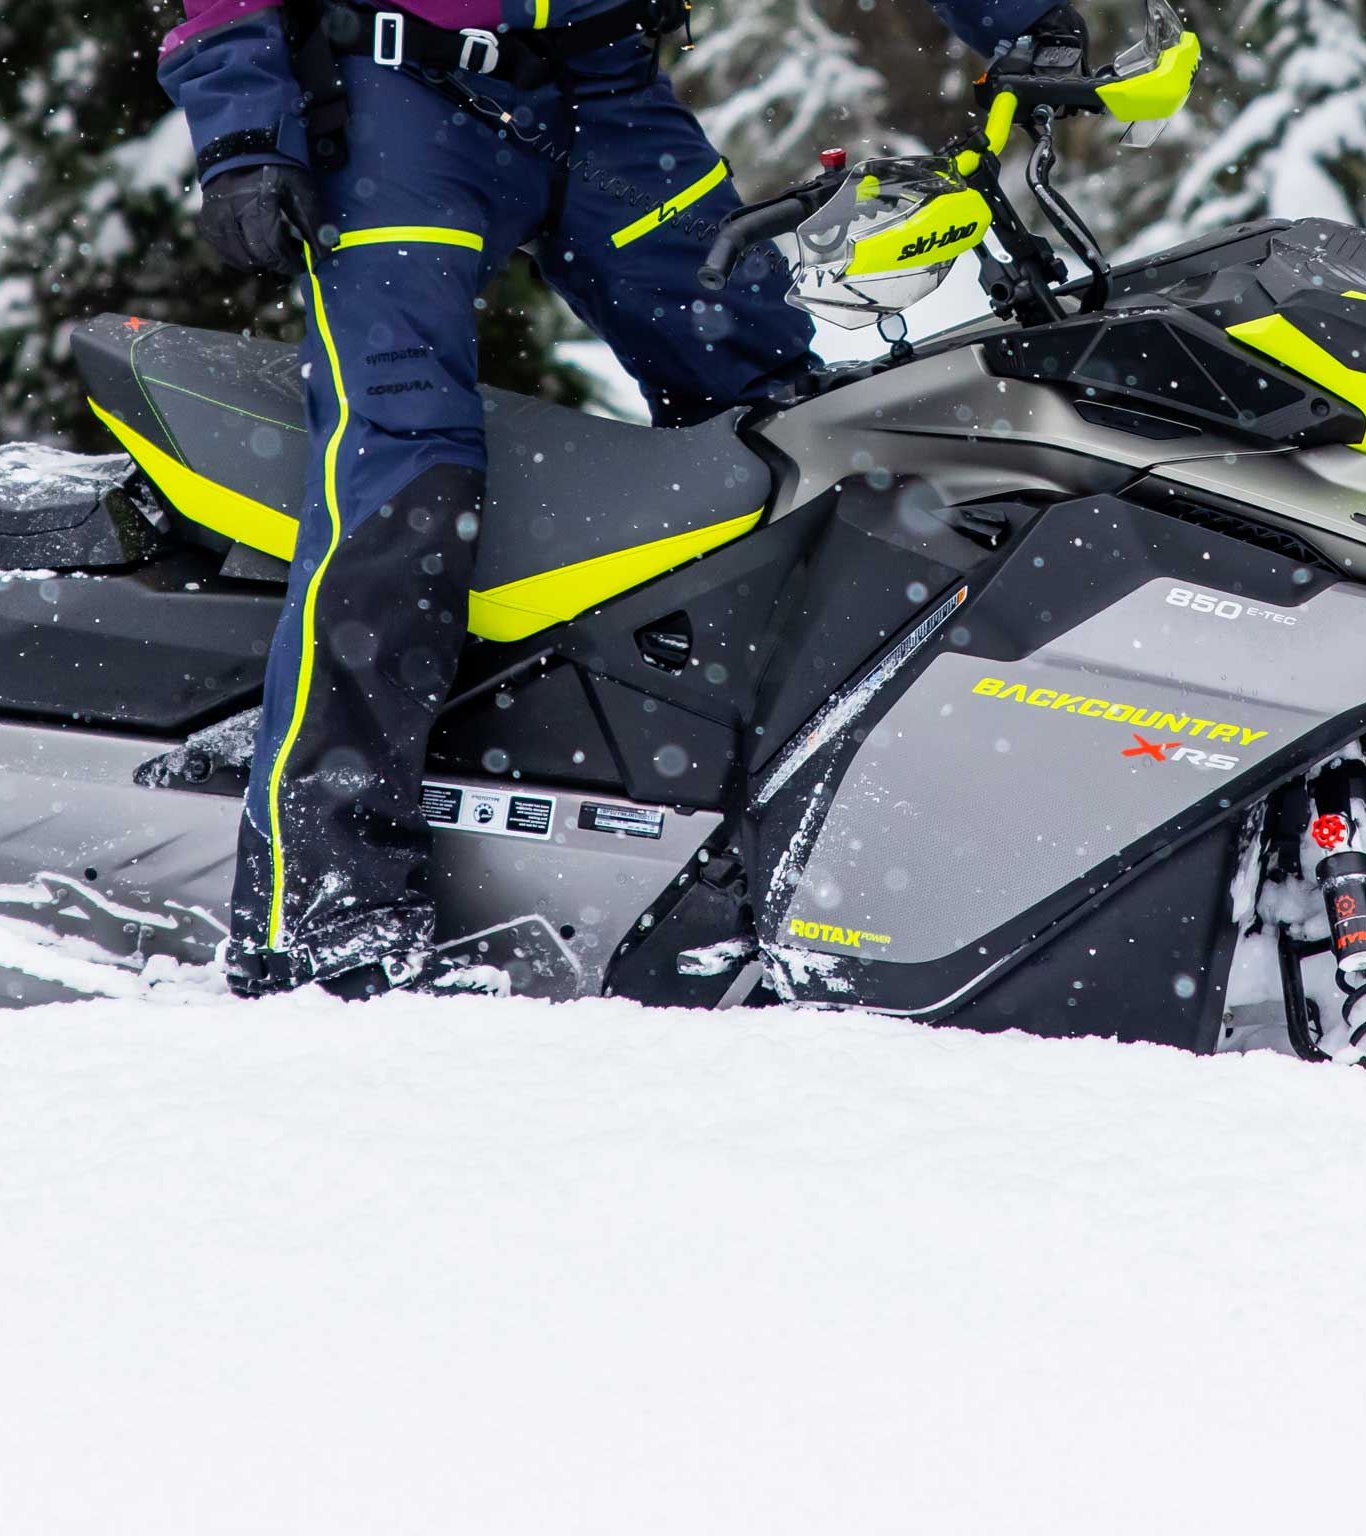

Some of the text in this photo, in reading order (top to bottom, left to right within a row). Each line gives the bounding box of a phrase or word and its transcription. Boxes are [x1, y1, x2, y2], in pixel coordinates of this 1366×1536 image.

[1165, 586, 1297, 626] 850 E-TEC
[971, 677, 1269, 746] BACKCOUNTRY
[790, 918, 892, 948] ROTAX POWER
